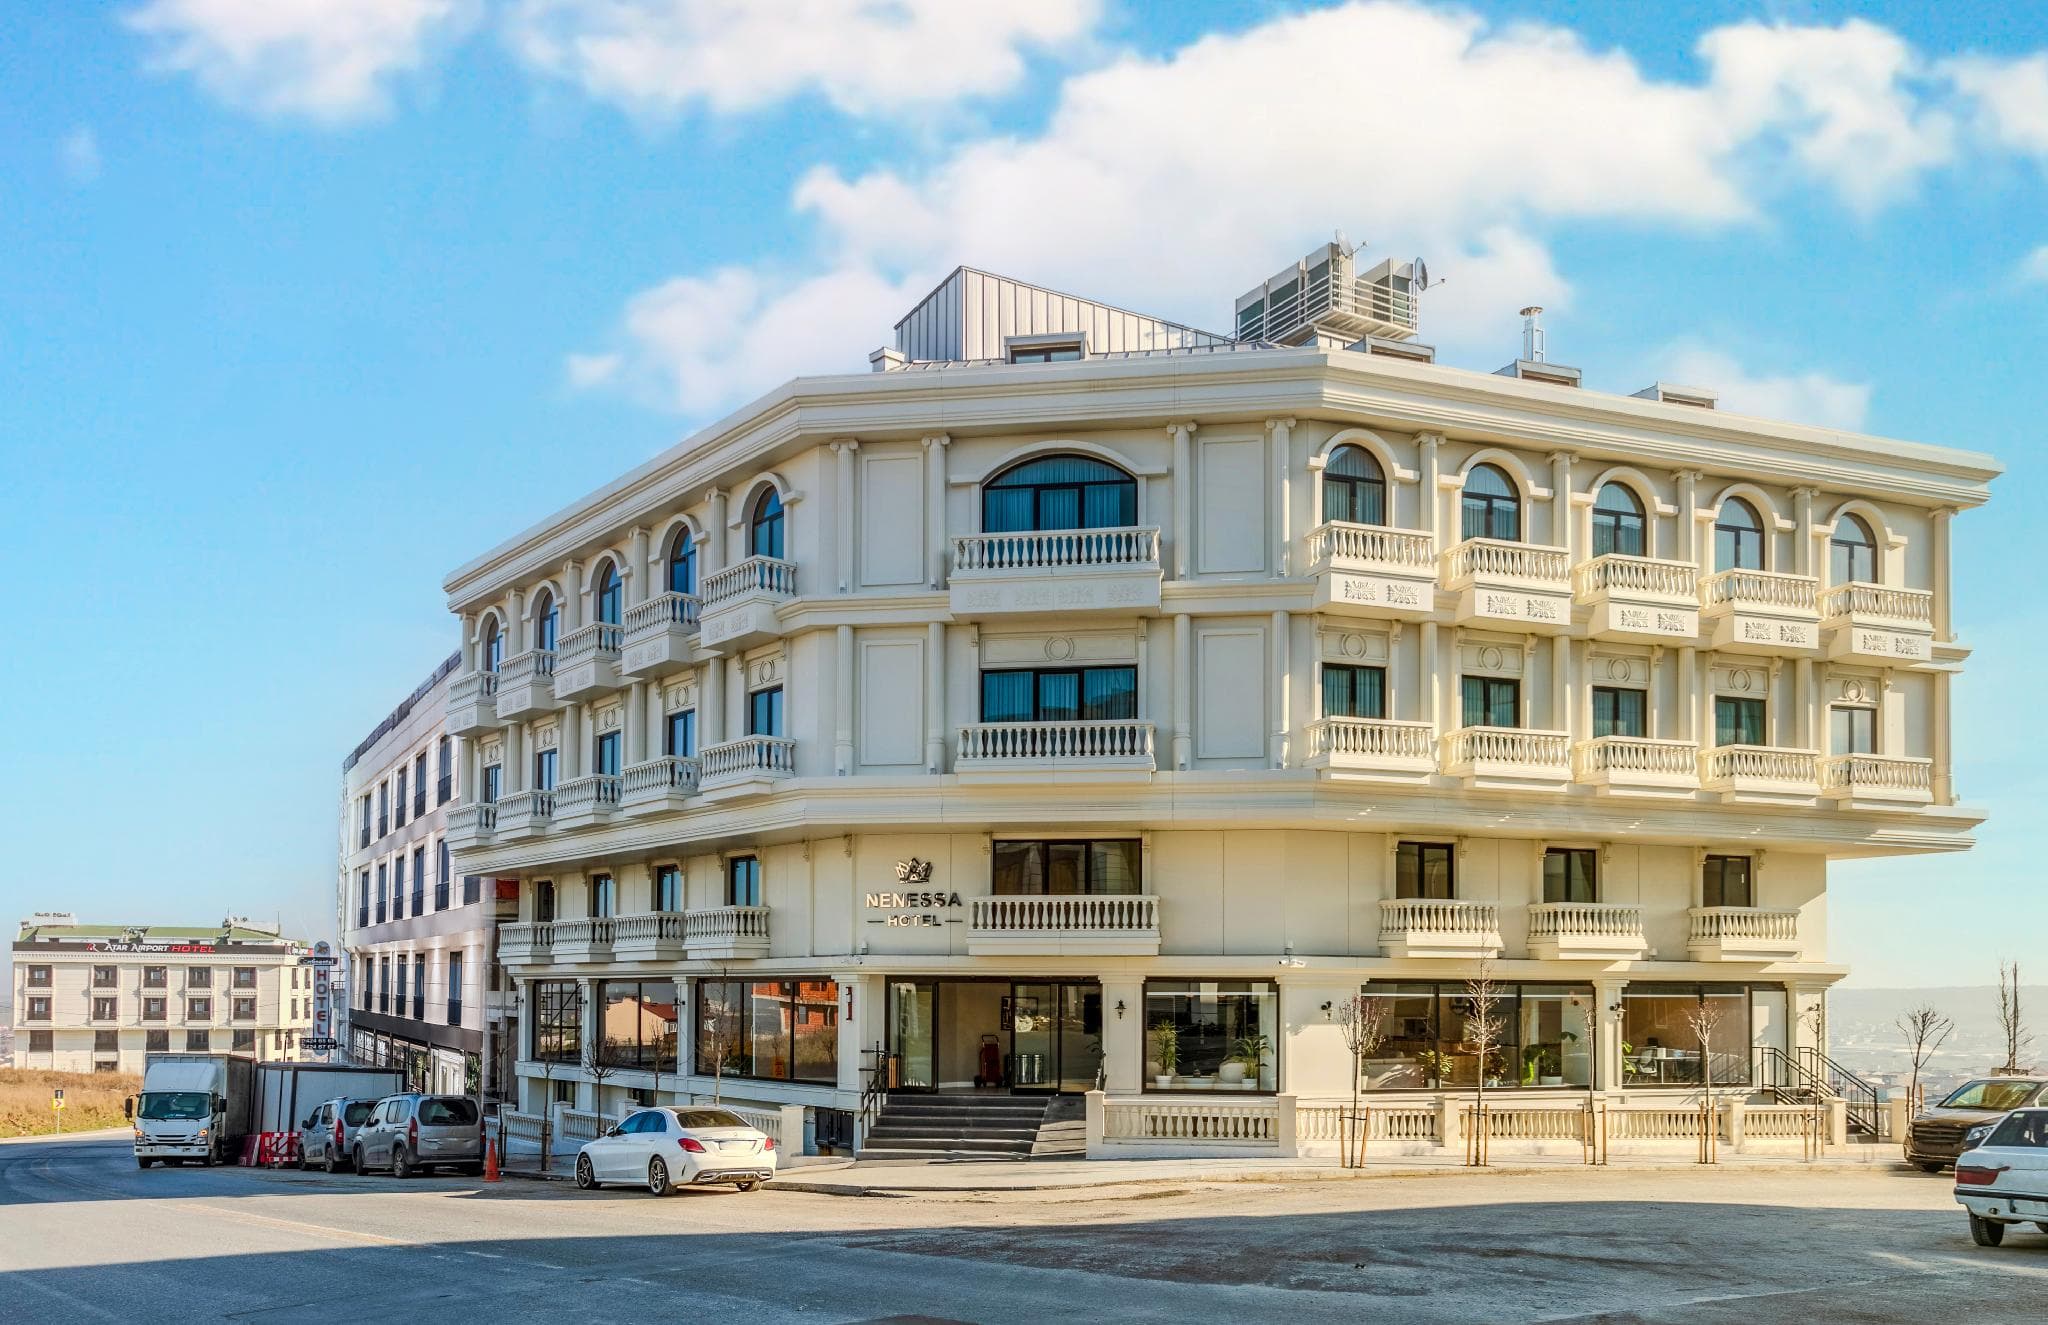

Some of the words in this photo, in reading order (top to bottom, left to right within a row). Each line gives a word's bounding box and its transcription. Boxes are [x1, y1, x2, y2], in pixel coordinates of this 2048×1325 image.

[866, 892, 962, 908] NENESSA
[887, 914, 942, 926] HOTEL
[104, 943, 128, 954] ATAR
[130, 943, 169, 954] AIRPORT
[171, 945, 216, 954] HOTEL
[316, 969, 327, 1035] HOTEL
